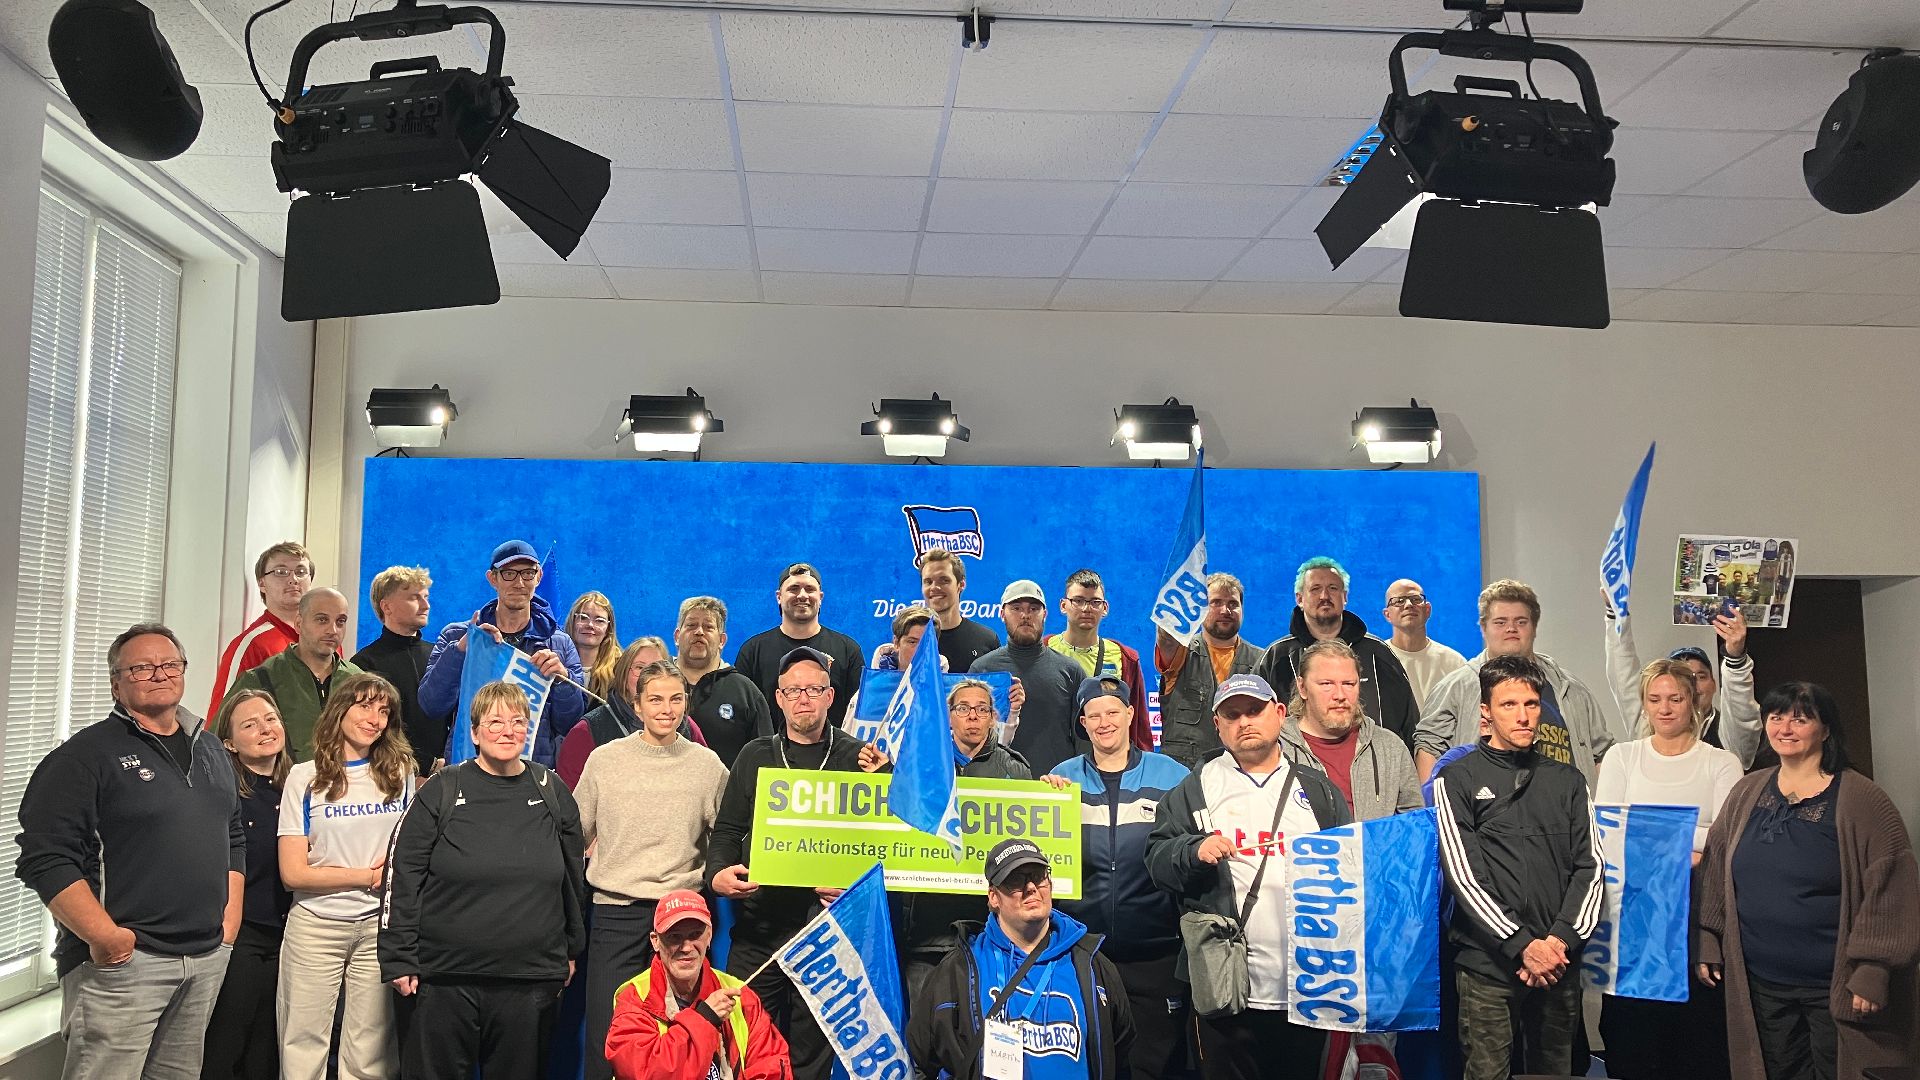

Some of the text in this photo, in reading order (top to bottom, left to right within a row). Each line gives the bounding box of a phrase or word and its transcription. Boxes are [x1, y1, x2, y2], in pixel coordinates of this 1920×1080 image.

[1742, 539, 1761, 551] Ola
[767, 779, 1072, 839] SCHICHCHSEL
[764, 836, 793, 852] Der
[796, 838, 888, 861] Aktionstag
[892, 842, 915, 858] für
[783, 921, 870, 1051] Hertha
[1294, 945, 1360, 1024] BSC
